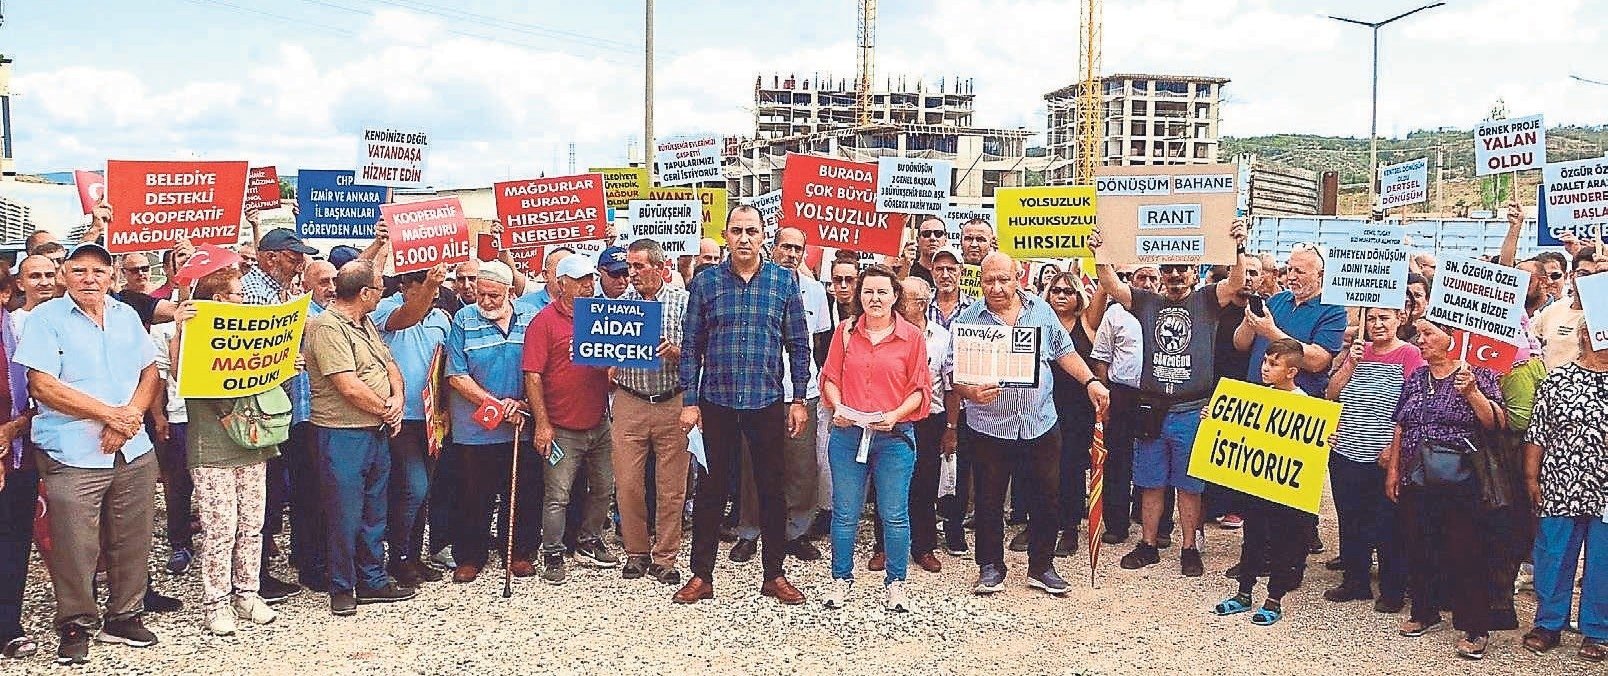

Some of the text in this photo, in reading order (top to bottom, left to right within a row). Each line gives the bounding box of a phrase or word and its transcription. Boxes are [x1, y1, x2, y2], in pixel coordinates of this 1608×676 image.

[1479, 120, 1540, 136] ÖRNEK PROJE
[365, 129, 427, 145] KENDİNİZE DEĞİL
[1483, 131, 1536, 150] YALAN
[368, 144, 421, 164] VATANDAŞA
[1488, 152, 1533, 169] OLDU
[146, 170, 216, 186] BELEDİYE
[363, 162, 421, 182] HİZMET EDİN
[604, 172, 638, 181] ELEDİYEYE
[820, 165, 873, 183] BURADA
[1561, 164, 1608, 178] ÖZGÜR ÖZ
[336, 175, 354, 185] CHP
[505, 180, 594, 197] MAĞDURLAR
[1097, 178, 1233, 193] DÖNÜŞÜM BAHANE
[1550, 180, 1608, 192] ADALET ARA
[145, 188, 214, 205] DESTEKLİ
[311, 188, 380, 202] İZMİR VE ANKARA
[805, 183, 833, 197] ÇOK
[1549, 191, 1608, 205] UZUNDERE
[521, 195, 580, 209] BURADA
[1020, 197, 1090, 207] YOLSUZLUK
[130, 206, 224, 225] KOOPERATİF
[315, 204, 375, 220] İL BAŞKANLARI
[392, 204, 456, 225] KOOPERATİF
[507, 207, 597, 227] HIRSIZLAR
[640, 204, 692, 220] BÜYÜKŞEHİR
[795, 201, 889, 229] YOLSUZLUK
[1147, 210, 1195, 224] RANT
[1573, 207, 1608, 220] BAŞLA
[112, 225, 237, 245] MAĞDURLARIYIZ
[301, 221, 349, 235] GÖREVDEN
[402, 223, 457, 242] MAĞDURU
[512, 225, 596, 243] NEREDE ?
[632, 220, 697, 236] VERDİĞİN SÖZÜ
[819, 224, 859, 244] VAR !
[1014, 235, 1090, 249] HIRSIZLI
[1142, 240, 1200, 254] ŞAHANE
[395, 238, 468, 267] 5.000 AİLE
[1329, 247, 1406, 262] BİTMEYEN DÖNÜŞÜM
[1341, 262, 1390, 275] ADINI TARİHE
[1445, 261, 1519, 287] SN. ÖZGÜR ÖZEL
[1332, 277, 1397, 289] ALTIN HARFLERLE
[1443, 276, 1516, 304] UZUNDERELİLER
[1346, 292, 1380, 302] YAZDIRDI
[590, 304, 645, 317] EV HAYAL,
[1444, 294, 1508, 319] OLARAK BİZDE
[213, 311, 299, 331] BELEDİYEYE
[590, 316, 644, 336] AİDAT
[1430, 307, 1516, 338] ADALET İSTİYORUZ!
[211, 330, 293, 350] GÜVENDİK
[212, 347, 290, 371] MAĞDUR
[579, 342, 653, 362] GERÇEK!
[223, 369, 280, 390] OLDUK!
[1212, 394, 1326, 447] GENEL KURUL
[1210, 430, 1304, 488] İSTİYORUZ
